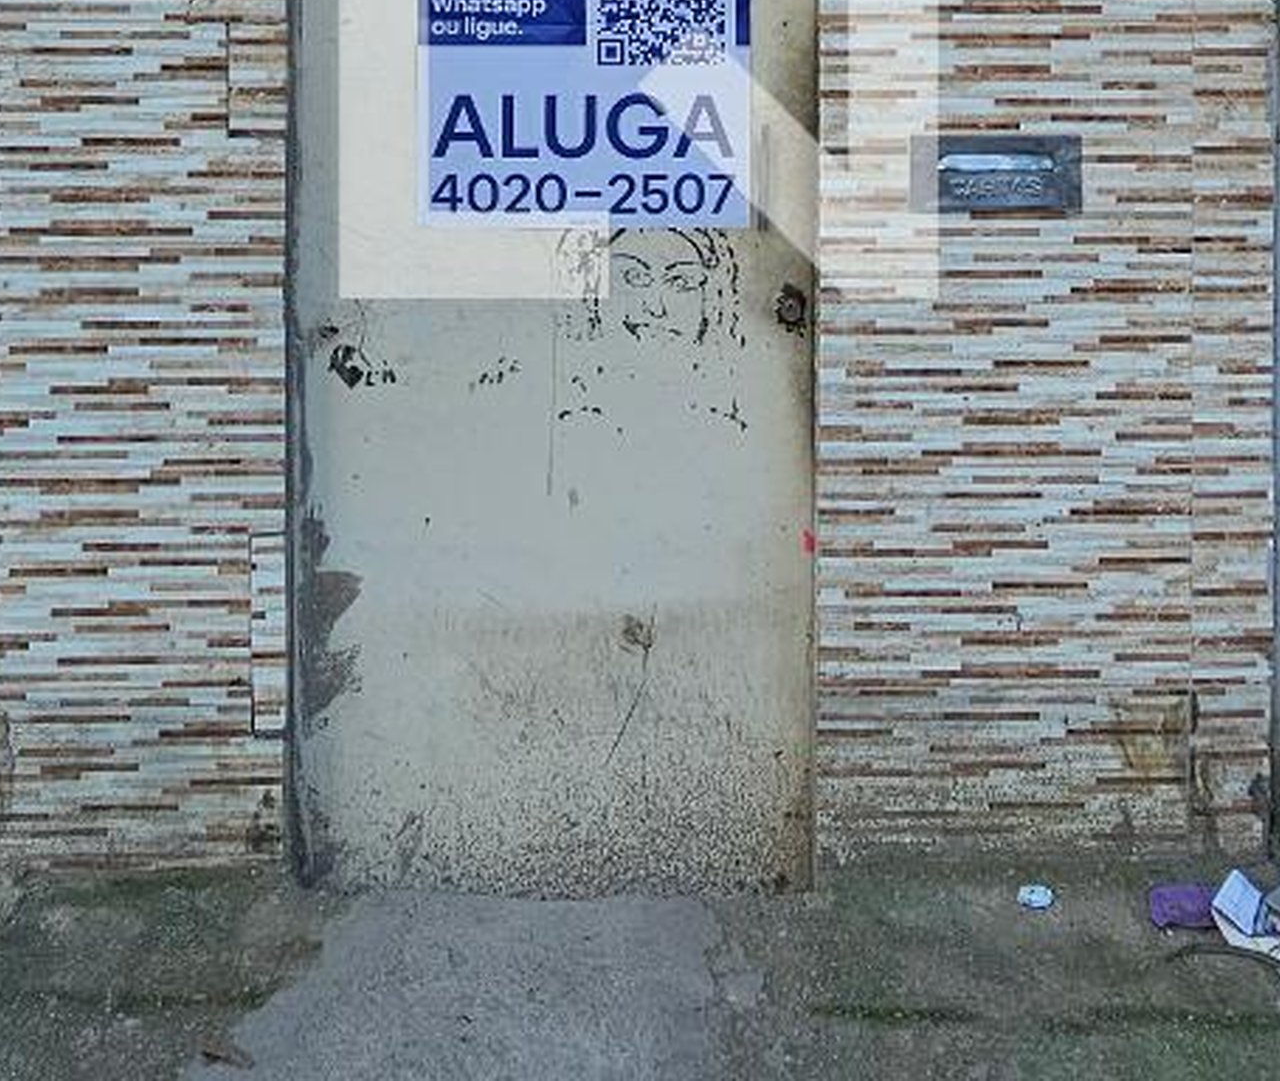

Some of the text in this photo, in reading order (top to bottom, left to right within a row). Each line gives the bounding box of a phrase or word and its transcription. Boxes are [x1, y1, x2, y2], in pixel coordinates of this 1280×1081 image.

[431, 17, 523, 40] ou ligue.
[432, 93, 735, 160] ALUGA
[430, 173, 735, 216] 4020-2507
